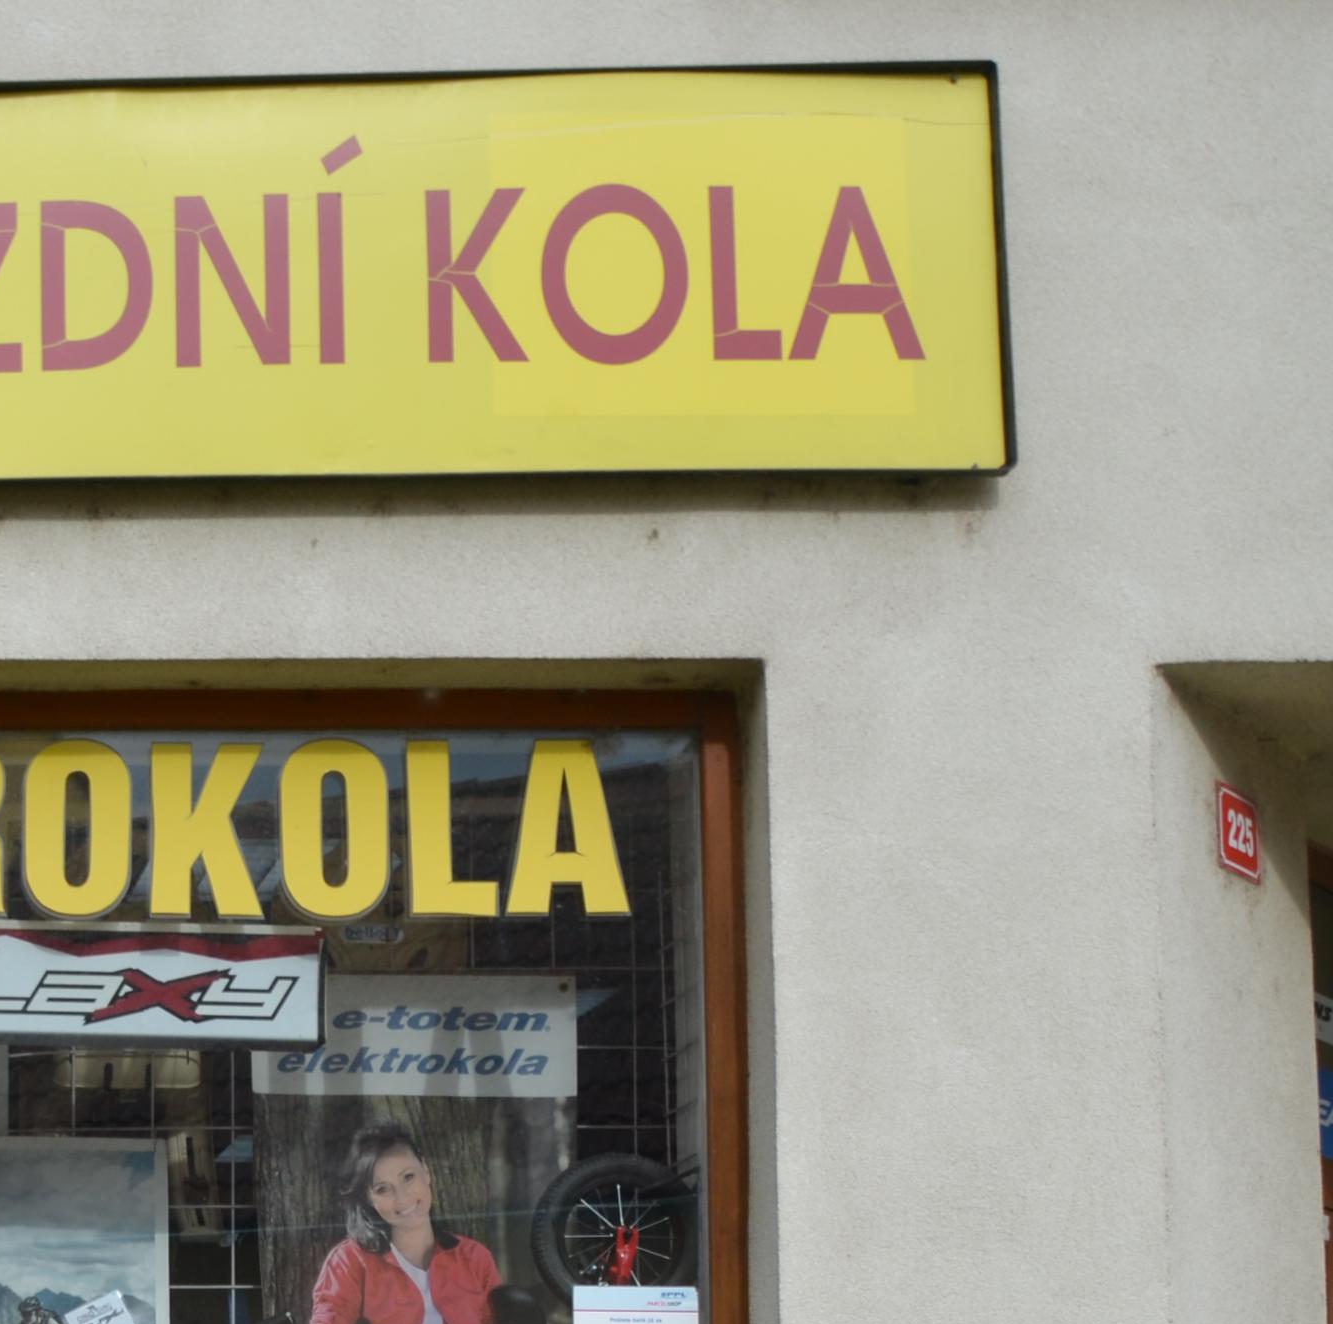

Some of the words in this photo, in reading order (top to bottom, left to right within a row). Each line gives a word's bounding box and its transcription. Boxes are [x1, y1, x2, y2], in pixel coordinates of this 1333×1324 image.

[423, 181, 927, 367] KOLA
[1227, 808, 1254, 858] 225
[331, 1004, 548, 1033] e-totem
[276, 1047, 548, 1078] elektrokola
